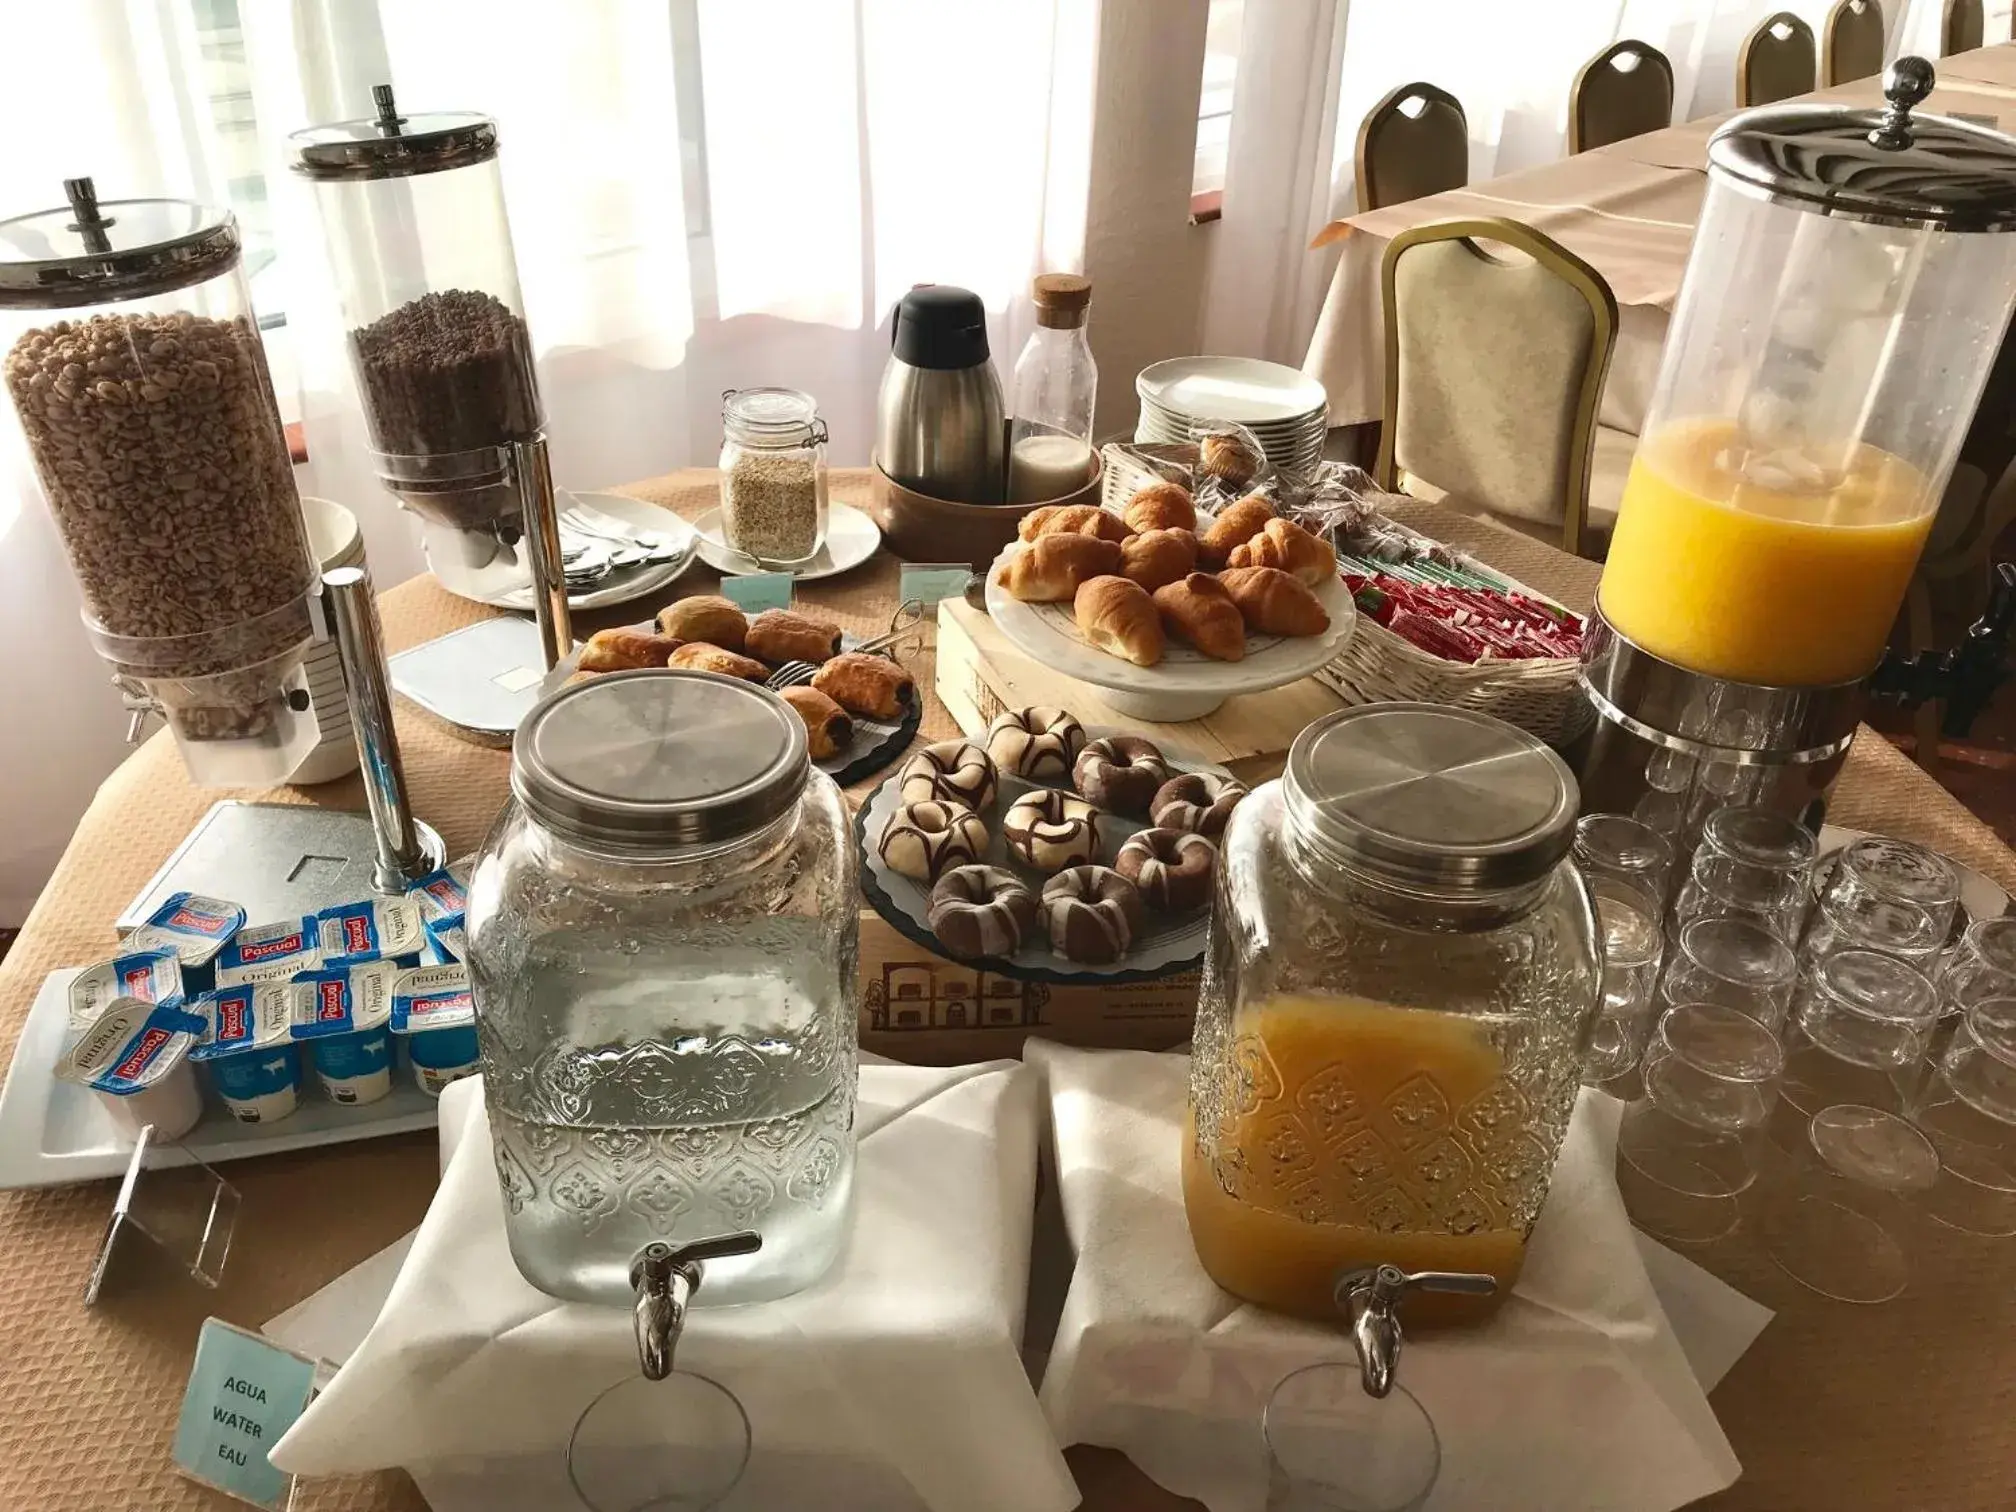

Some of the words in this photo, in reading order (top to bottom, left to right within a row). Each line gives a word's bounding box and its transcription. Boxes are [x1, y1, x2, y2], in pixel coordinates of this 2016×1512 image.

[349, 918, 364, 952] Pascual
[387, 907, 406, 944] Original
[244, 938, 297, 957] Pascual
[242, 962, 304, 980] Original
[412, 972, 465, 986] riginal
[325, 984, 337, 1018] Pascual
[367, 972, 385, 1012] Original
[417, 996, 471, 1011] Pascual
[224, 1003, 238, 1037] Pascual
[268, 990, 287, 1031] Original
[78, 1017, 129, 1069] Original
[123, 1031, 166, 1075] Pascual
[224, 1376, 267, 1404] AGUA
[213, 1406, 262, 1438] WATER
[218, 1444, 247, 1467] EAU
